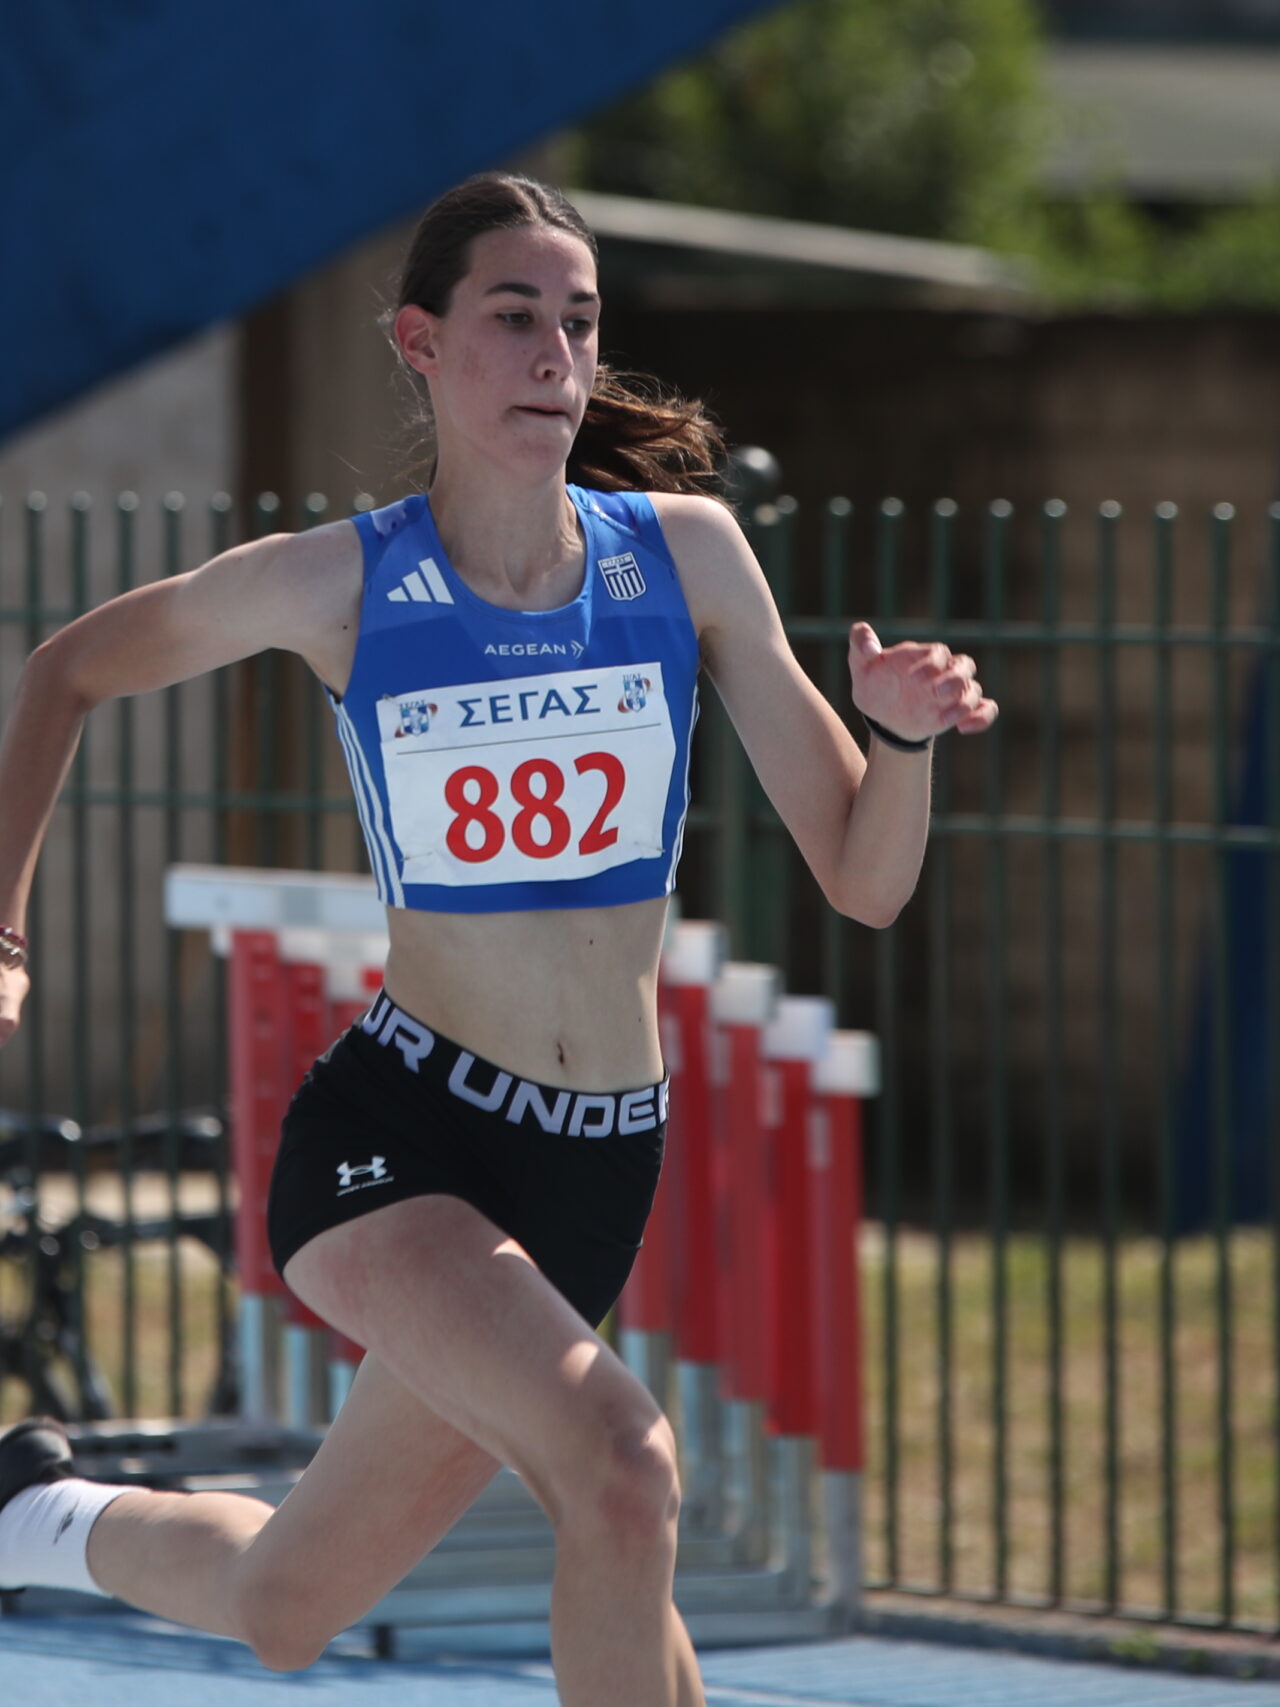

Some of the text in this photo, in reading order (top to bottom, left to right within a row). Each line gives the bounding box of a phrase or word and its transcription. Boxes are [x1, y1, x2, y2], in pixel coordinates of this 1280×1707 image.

[484, 642, 566, 656] AEGEAN
[458, 684, 601, 728] ΣΕΓΑΣ
[444, 751, 626, 864] 882
